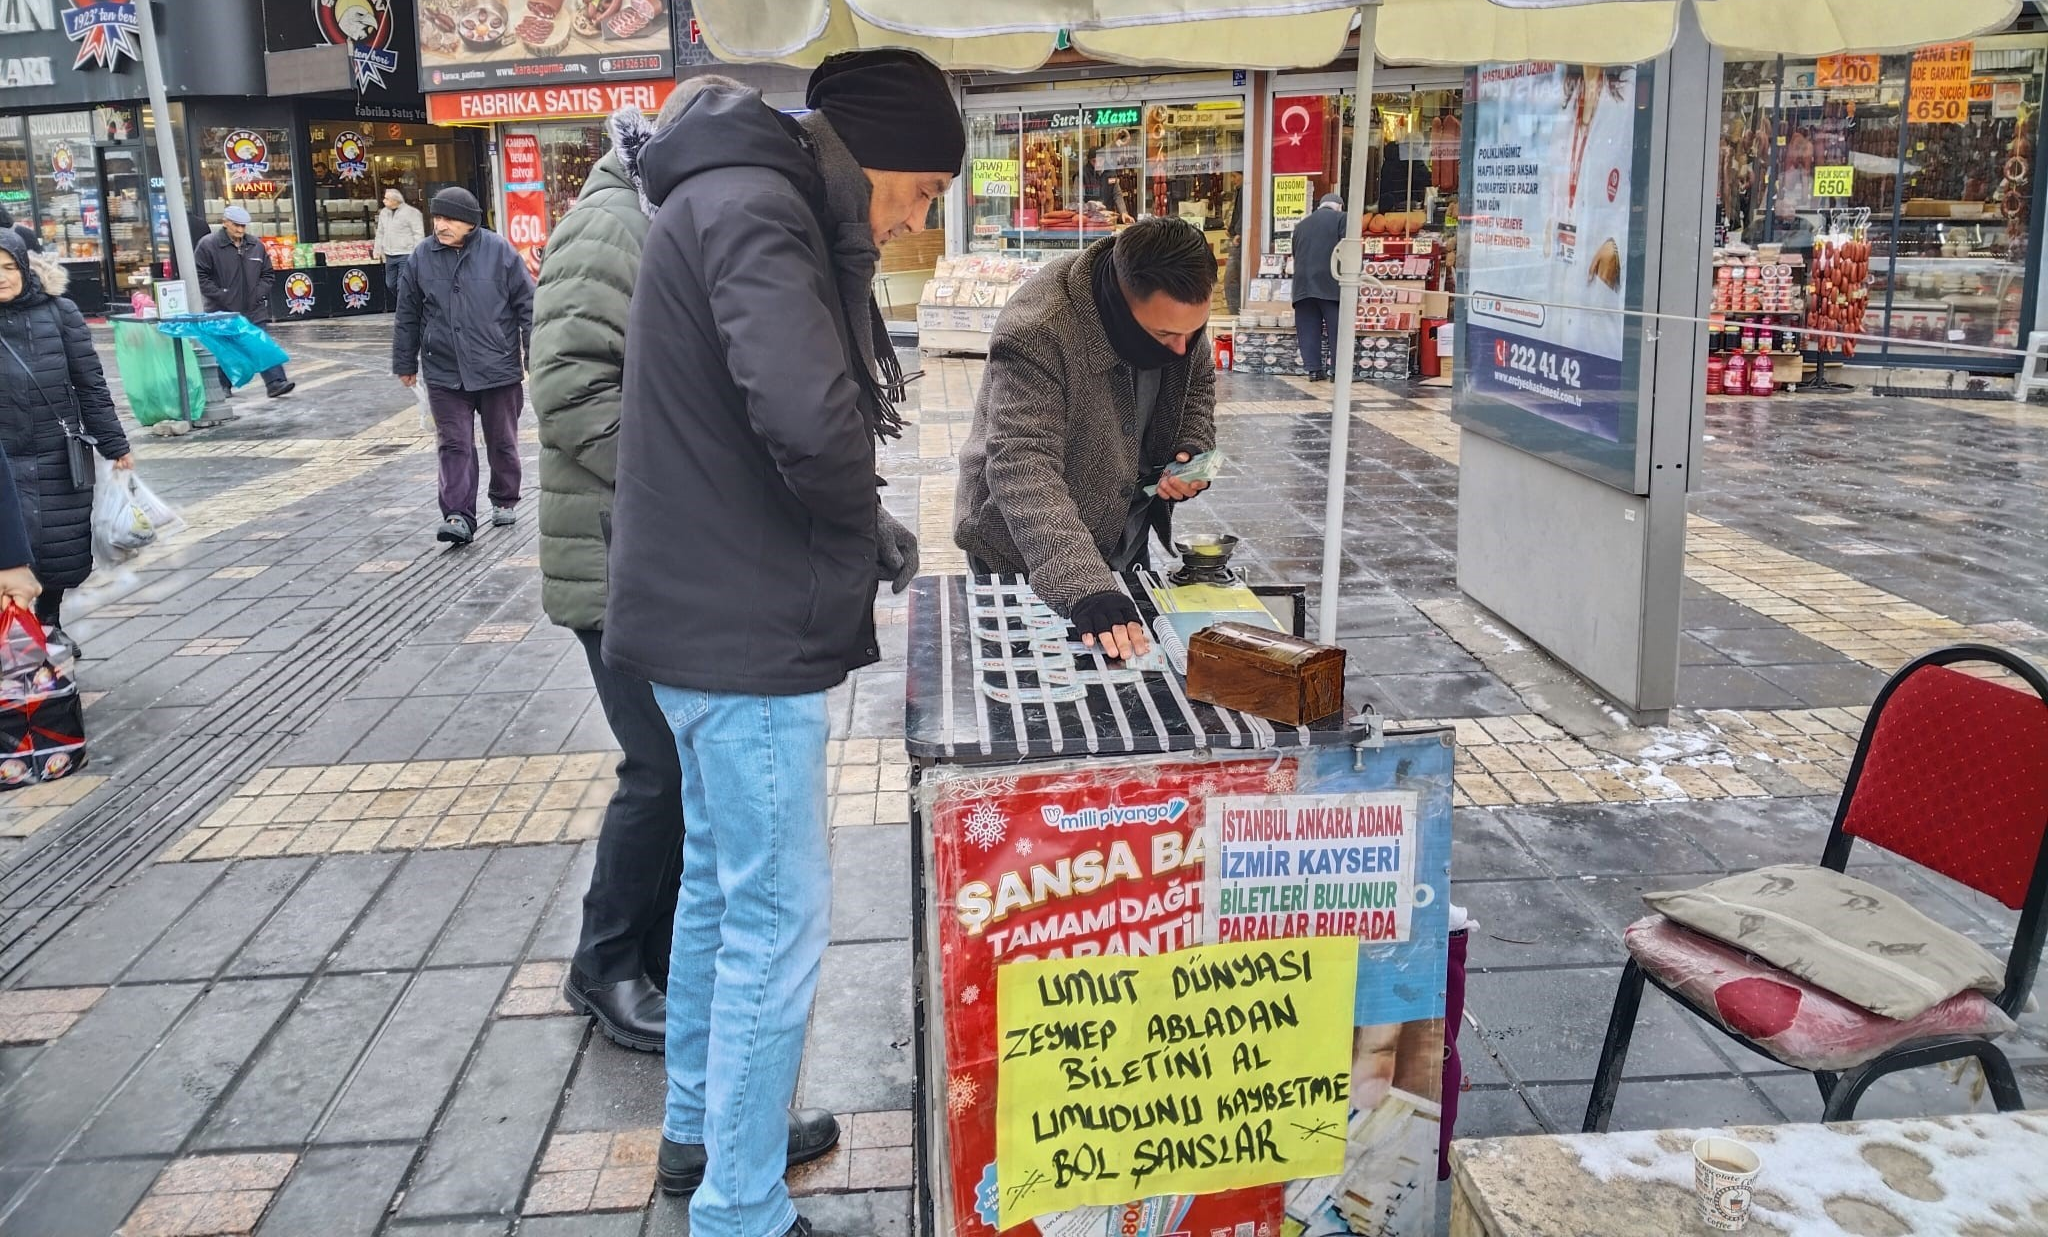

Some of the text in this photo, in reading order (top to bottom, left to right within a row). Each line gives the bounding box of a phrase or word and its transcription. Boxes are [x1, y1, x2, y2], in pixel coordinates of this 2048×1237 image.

[1831, 63, 1871, 82] 400
[355, 105, 390, 118] Fabrika
[460, 85, 656, 117] FABRİKA SATIŞ YERİ
[1916, 100, 1960, 119] 650
[1503, 164, 1516, 176] HER
[1818, 180, 1845, 194] 650
[1509, 183, 1517, 194] VE
[1517, 183, 1538, 195] PAZAR
[1276, 206, 1291, 215] SIRT
[510, 215, 540, 243] 650
[1510, 344, 1581, 388] 222 41 42
[1061, 803, 1168, 830] milli piyango
[1222, 802, 1404, 843] İSTANBUL ANKARA ADANA
[1221, 838, 1401, 879] İZMİR KAYSERİ
[958, 839, 1143, 938] ŞANSA
[1219, 877, 1309, 916] BİLETLERİ
[1313, 880, 1398, 910] BULUNUR
[986, 901, 1117, 958] TAMAMI
[1218, 910, 1397, 944] PARALAR BURADA
[1037, 950, 1313, 1007] UMUT DÜNYASI
[1003, 993, 1300, 1064] ZEYNEP ABLADAN
[1059, 1041, 1272, 1092] BİLETİNİ AL
[1031, 1072, 1350, 1144] UMUDUNU KAYBETME
[1053, 1118, 1290, 1190] BOL ŞANSLAR
